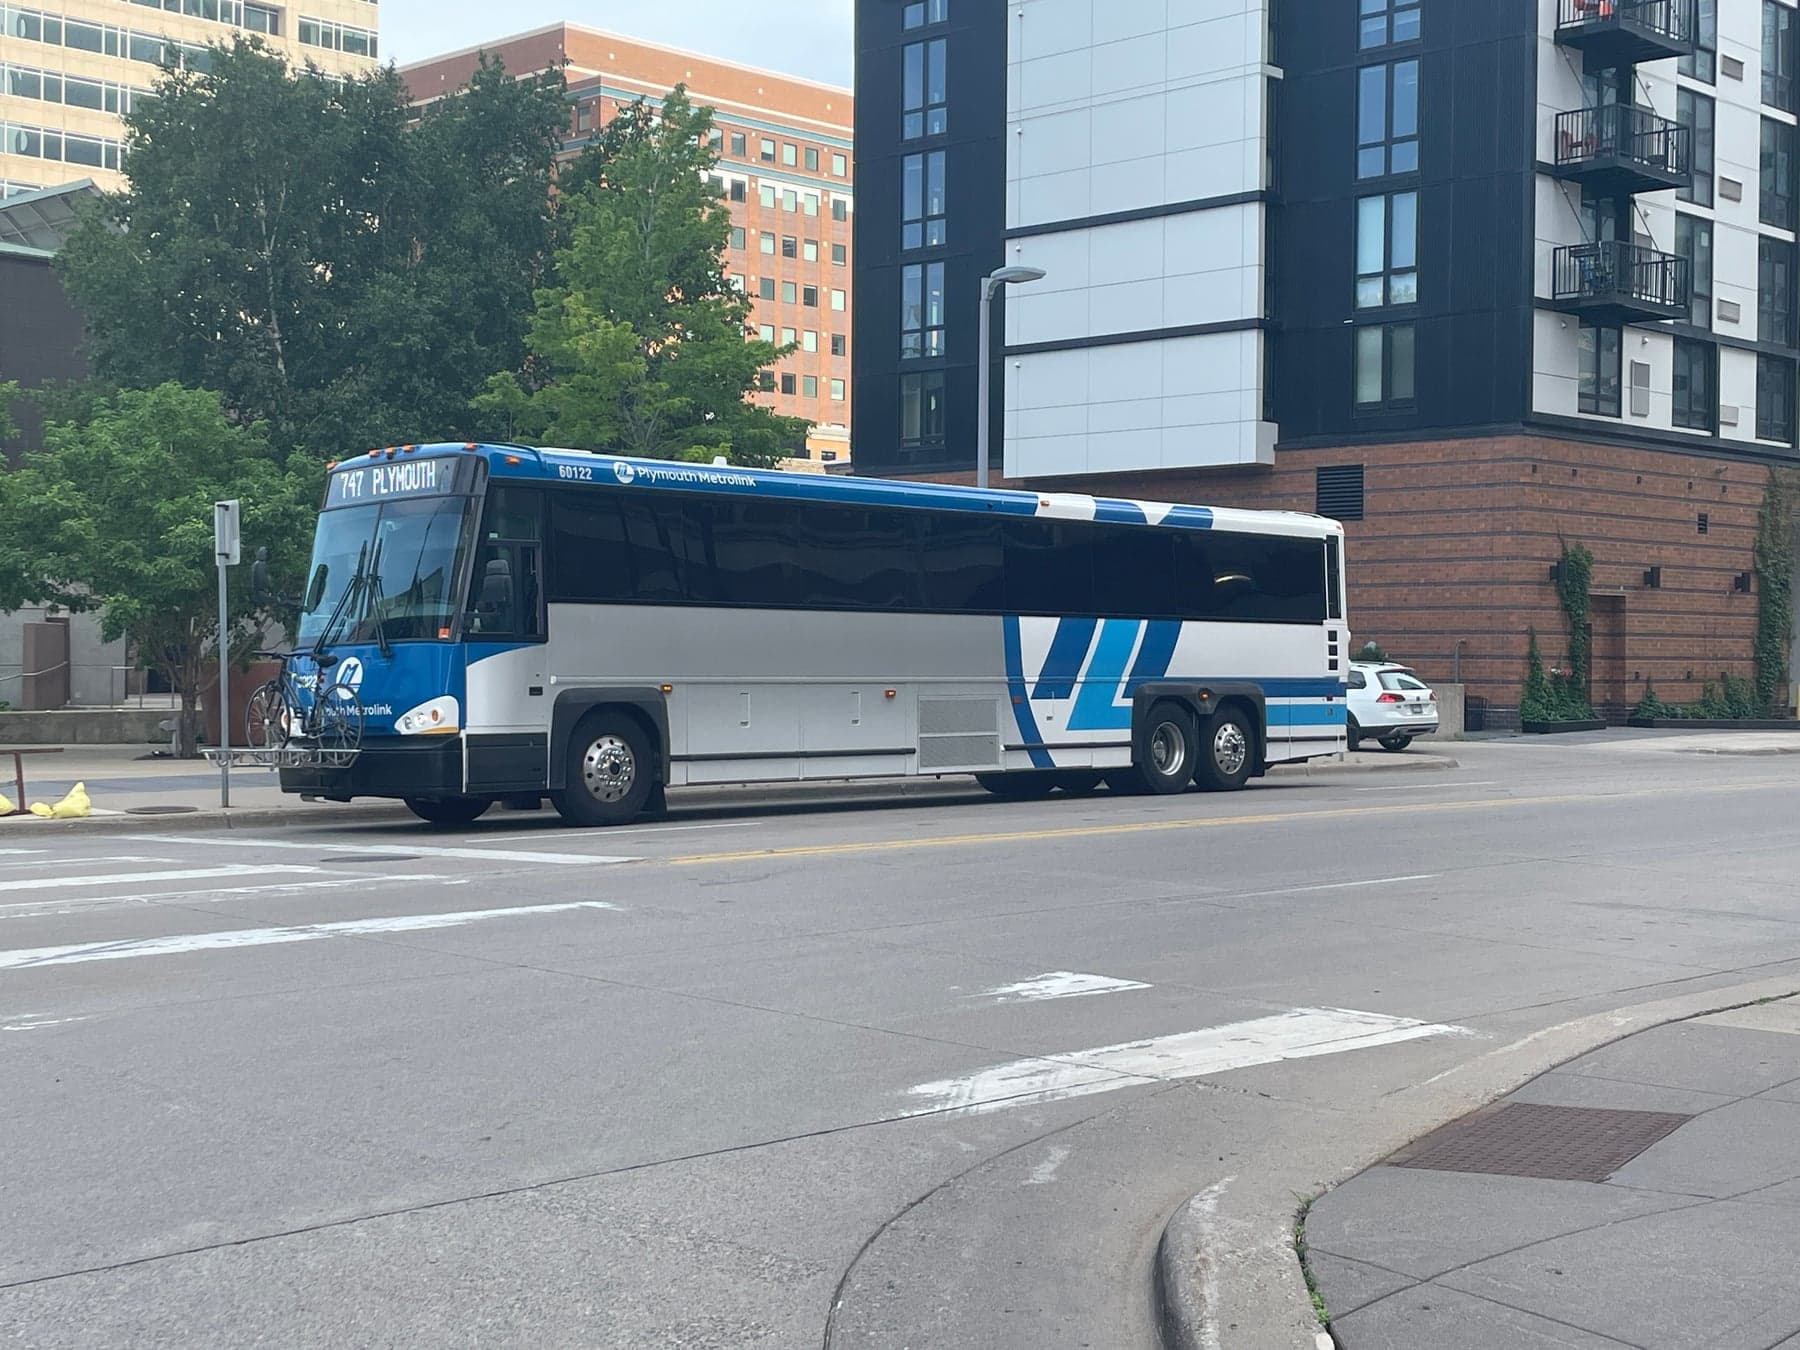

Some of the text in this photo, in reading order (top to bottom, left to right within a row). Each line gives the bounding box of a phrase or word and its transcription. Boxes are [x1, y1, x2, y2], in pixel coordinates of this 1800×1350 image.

[340, 460, 436, 499] 747 PLYMOUTH
[558, 465, 593, 480] 60122
[637, 466, 757, 487] Plymouth Metrolink
